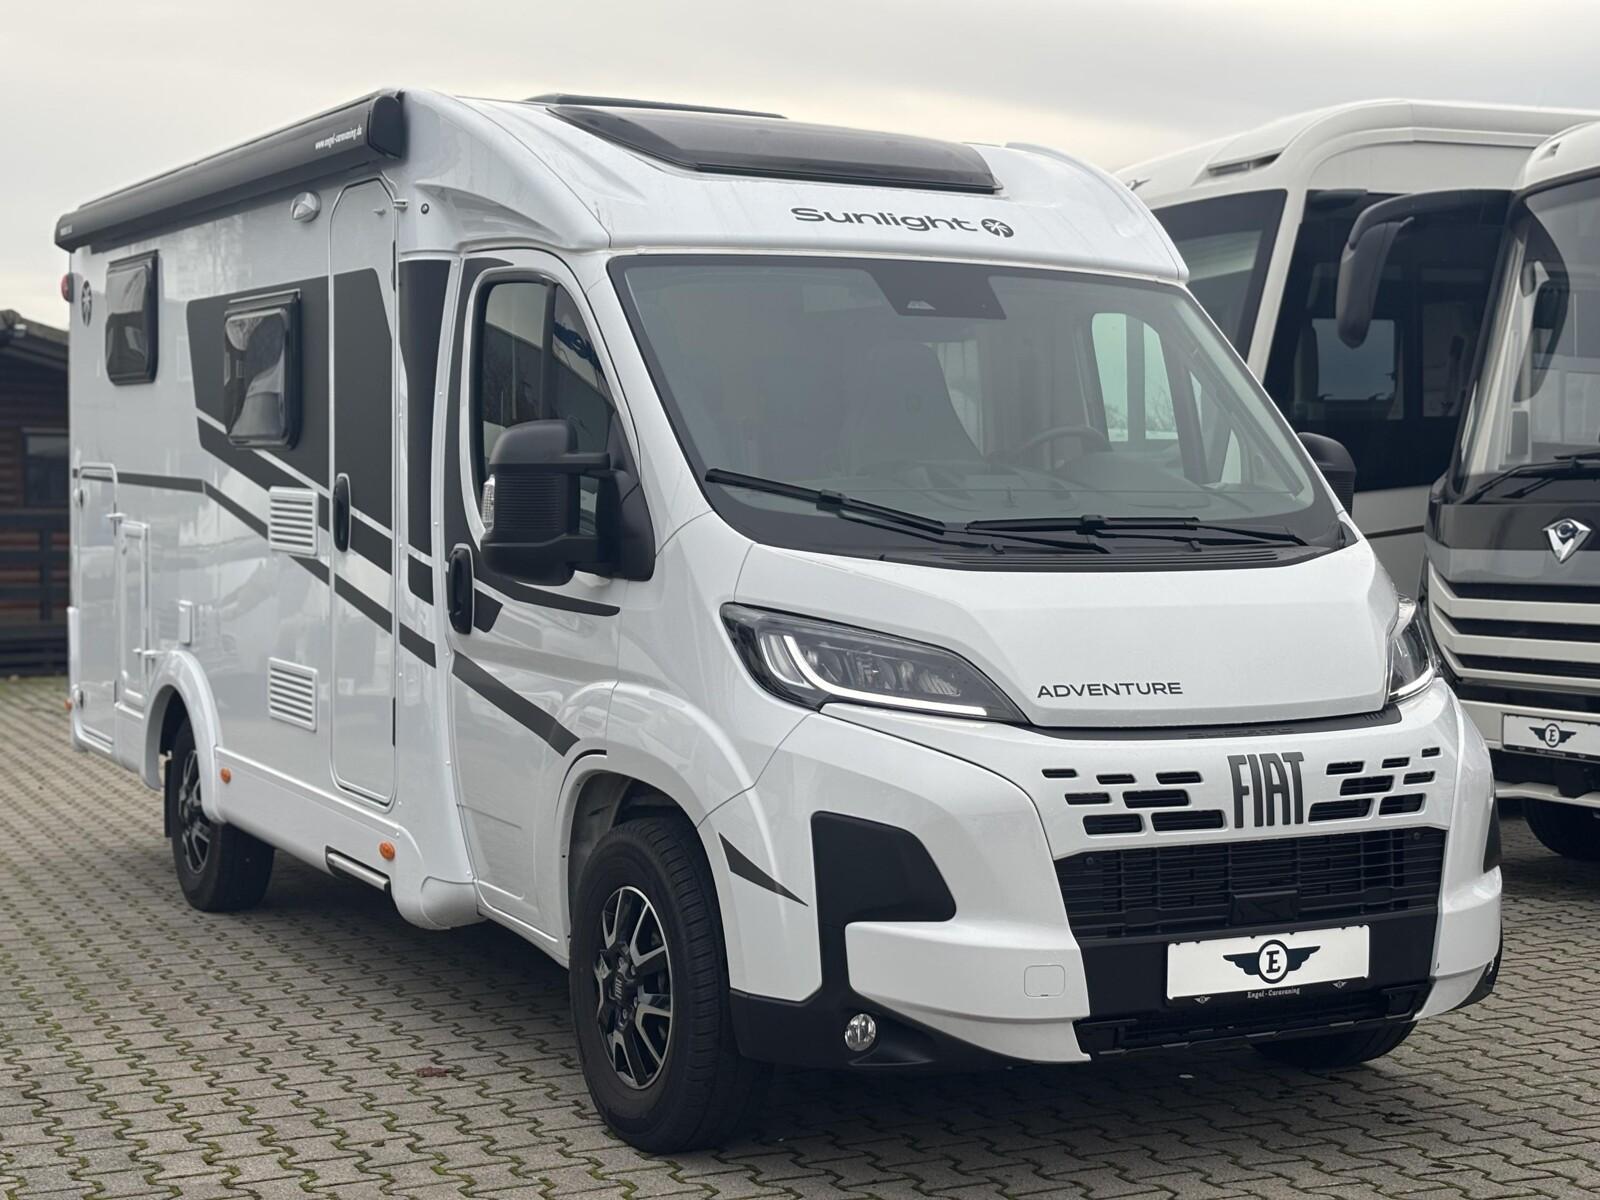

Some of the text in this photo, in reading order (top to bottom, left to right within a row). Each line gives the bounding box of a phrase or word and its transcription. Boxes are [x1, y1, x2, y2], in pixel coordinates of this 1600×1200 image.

[791, 207, 978, 232] Sunlight
[1037, 682, 1183, 699] ADVENTURE
[1227, 751, 1305, 829] FIAT
[1265, 950, 1281, 974] E
